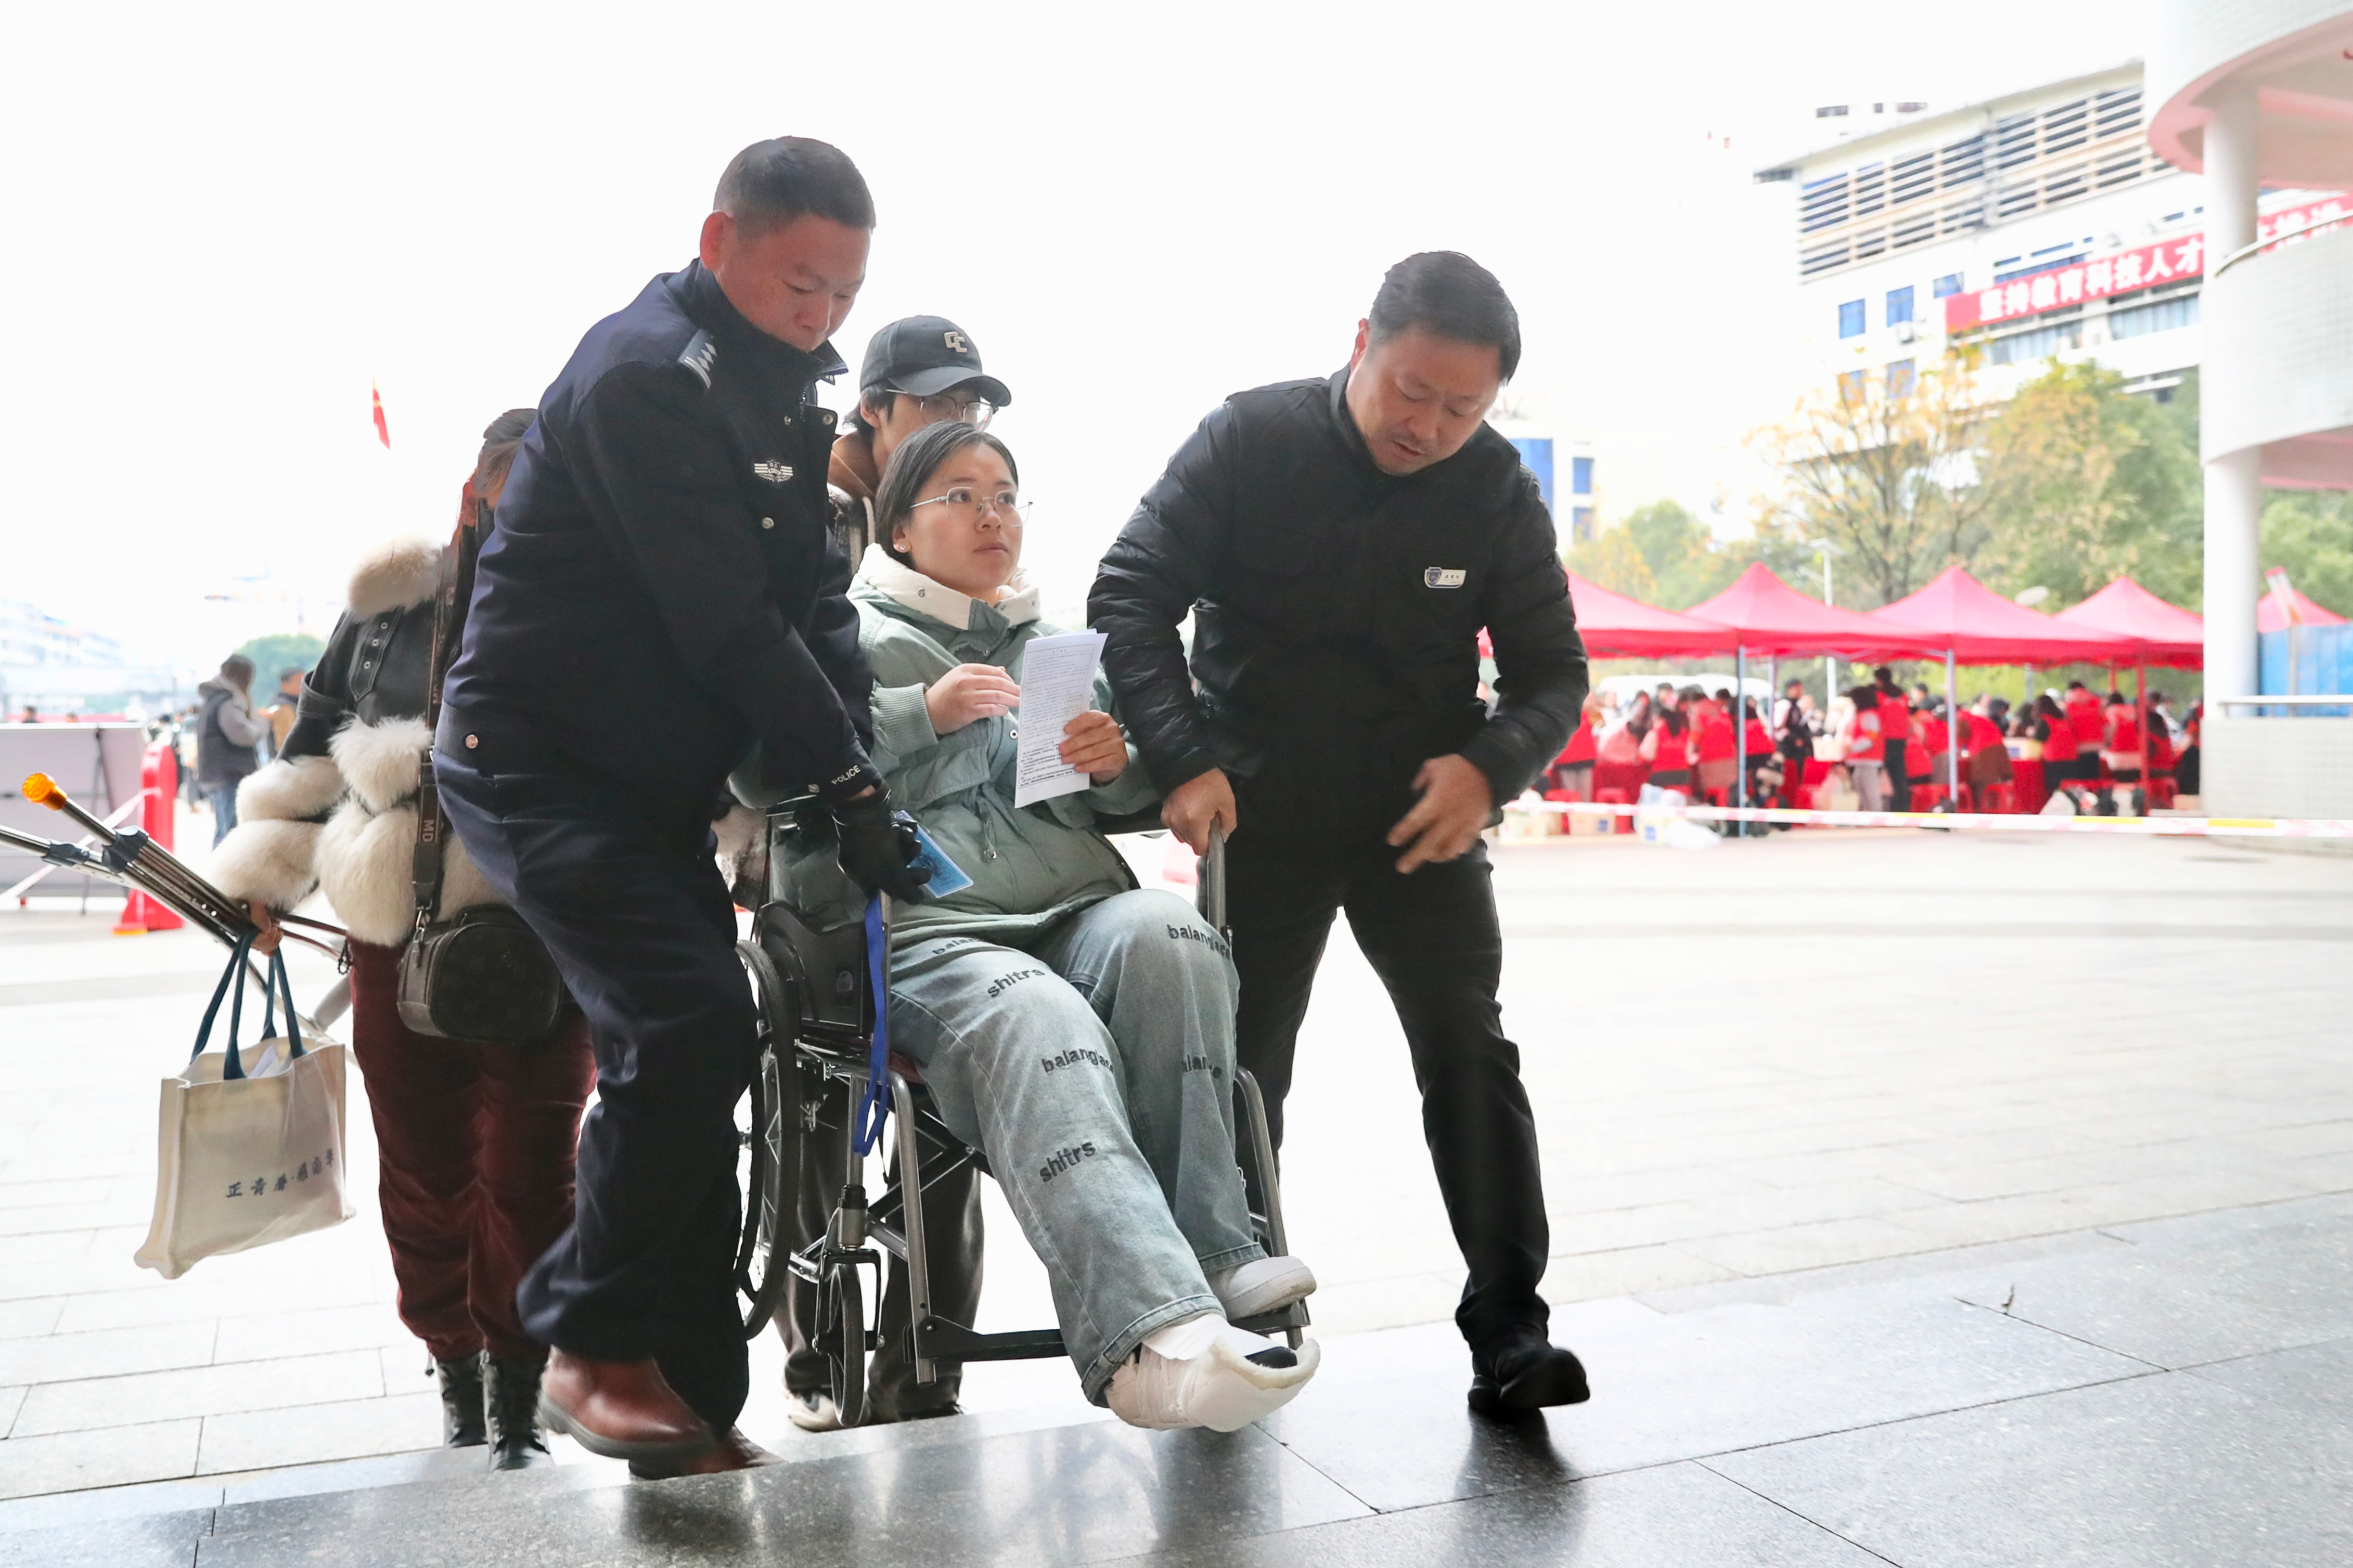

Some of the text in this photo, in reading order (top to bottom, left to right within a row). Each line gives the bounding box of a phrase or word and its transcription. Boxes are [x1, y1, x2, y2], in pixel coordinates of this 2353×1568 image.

[831, 765, 860, 784] POLICE
[988, 969, 1045, 997] shitrs
[1039, 1142, 1096, 1182] shitrs
